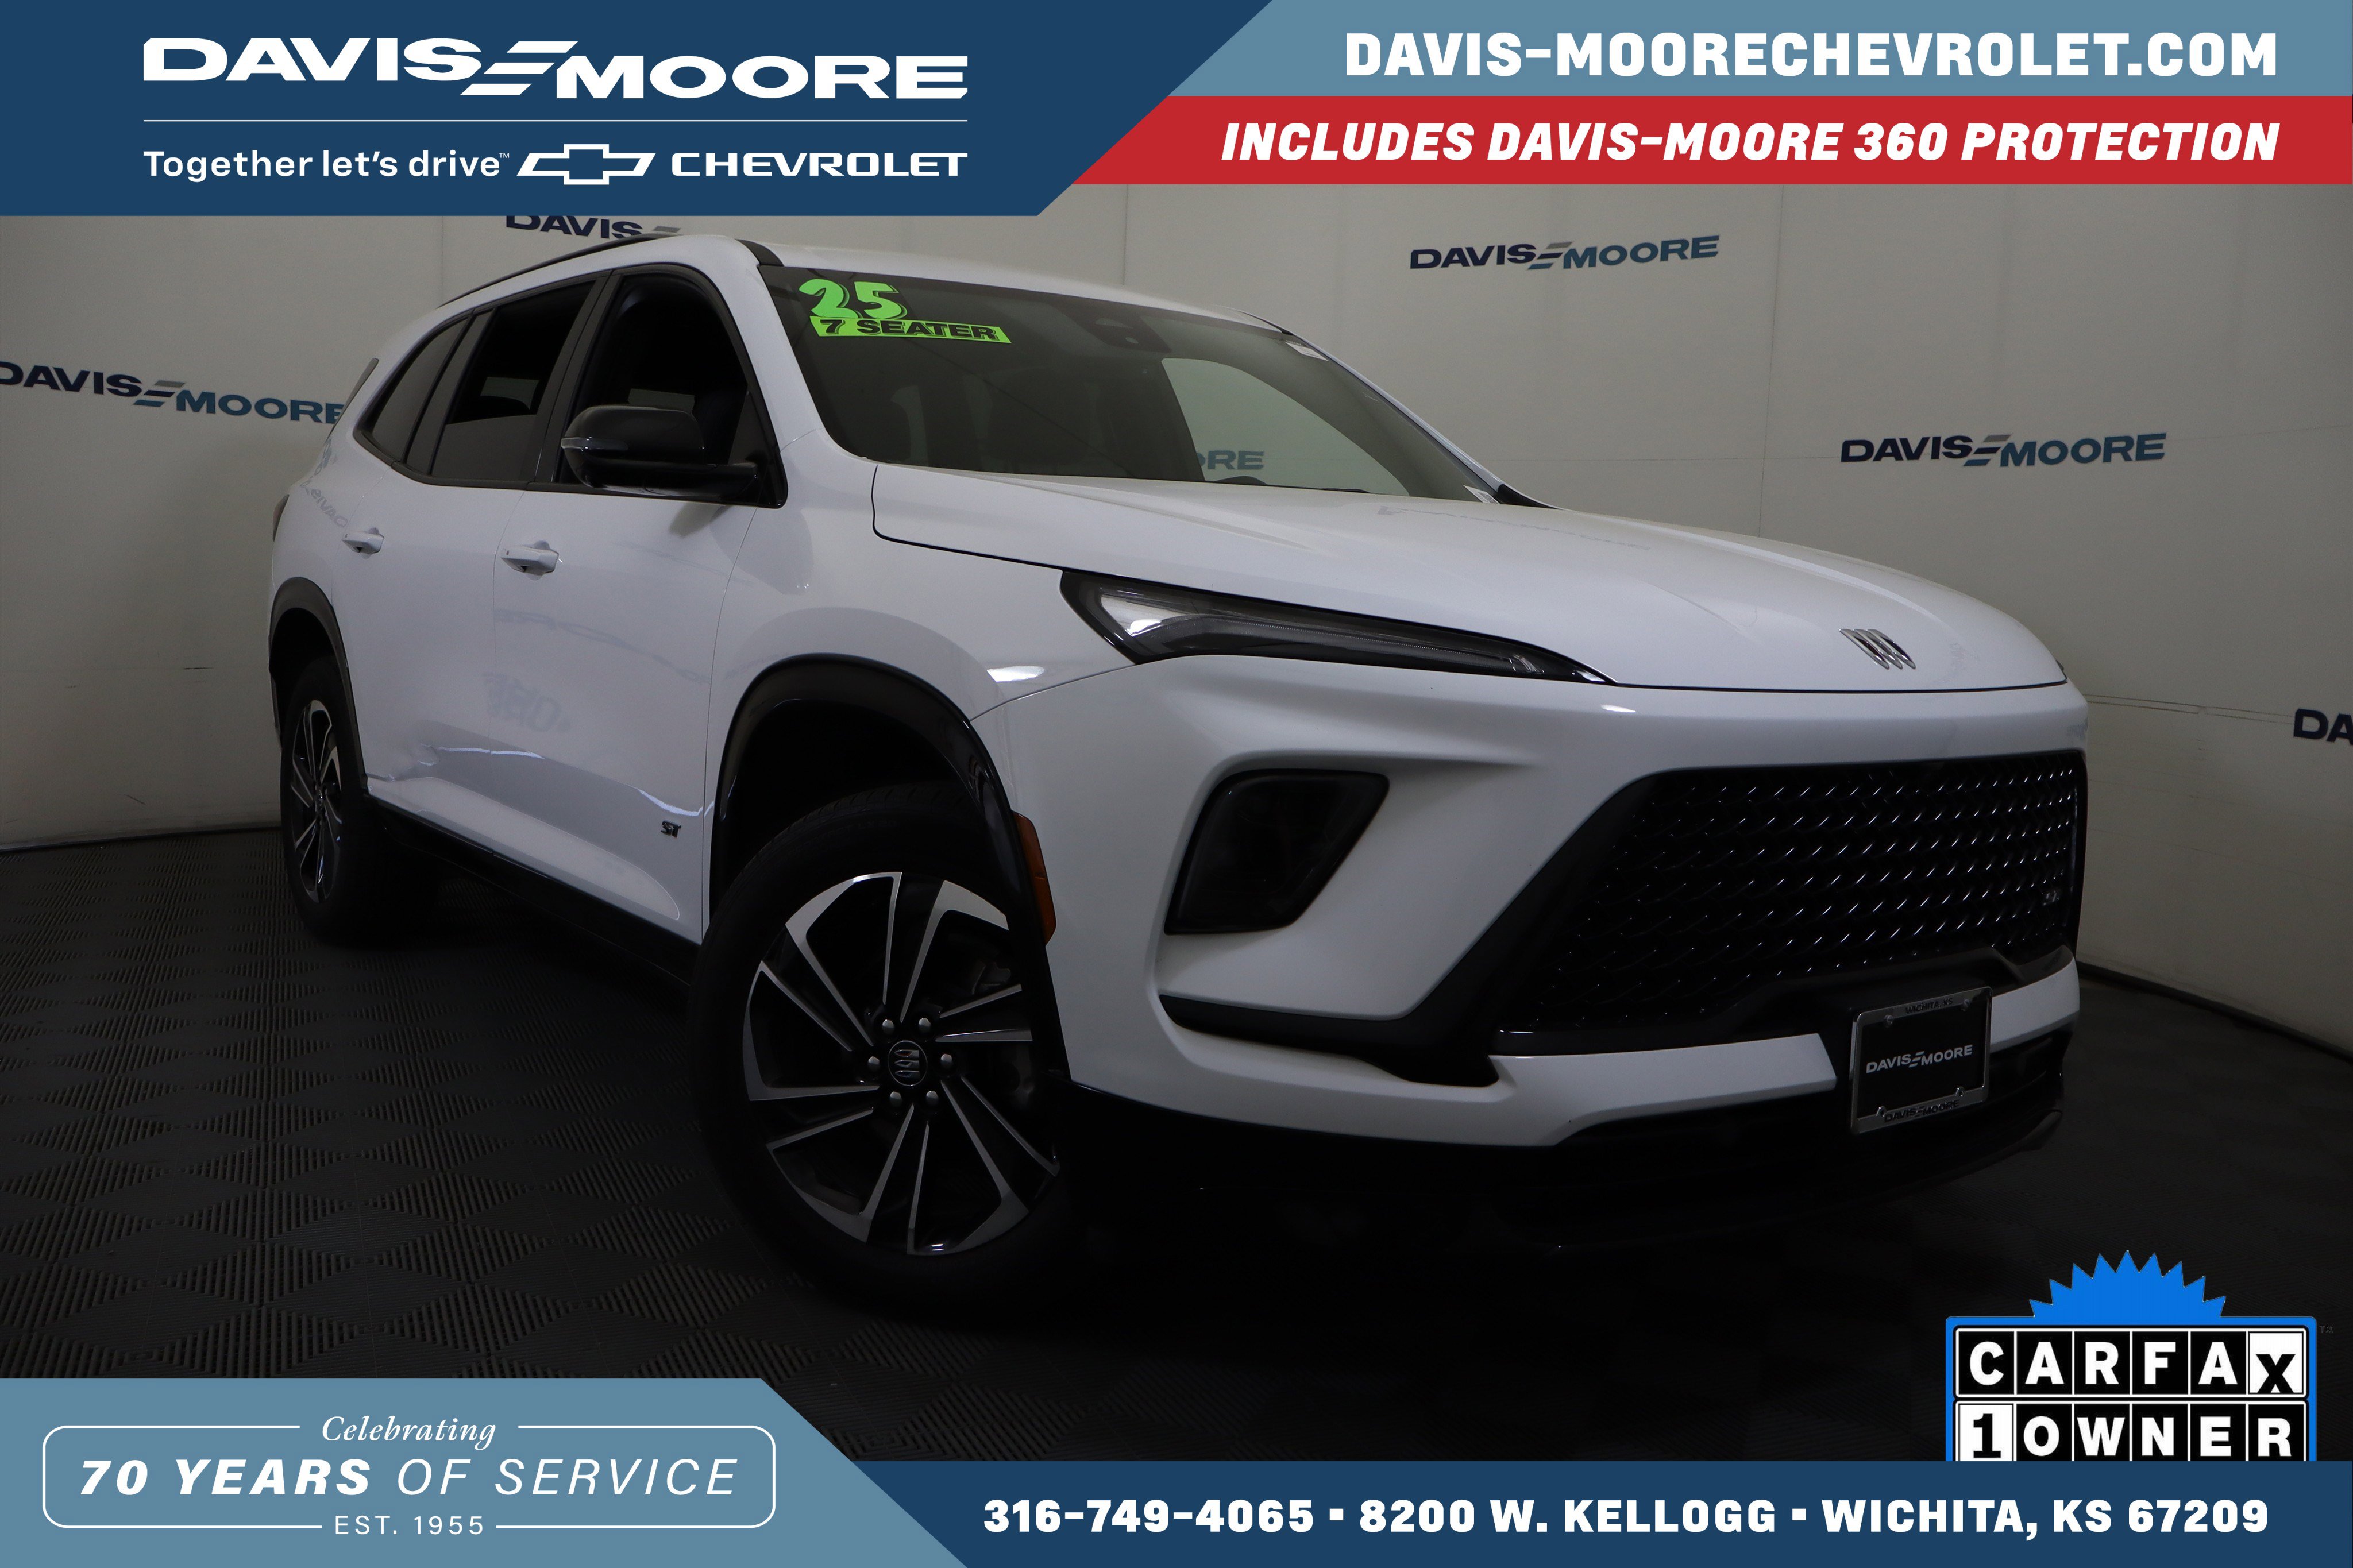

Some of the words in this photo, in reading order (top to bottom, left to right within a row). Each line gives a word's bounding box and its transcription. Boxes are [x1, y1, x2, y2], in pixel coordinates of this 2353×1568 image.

[506, 216, 643, 239] DAVIS
[799, 279, 907, 319] 25
[820, 319, 846, 335] 7
[857, 320, 1000, 341] SEATER
[661, 820, 681, 839] ST
